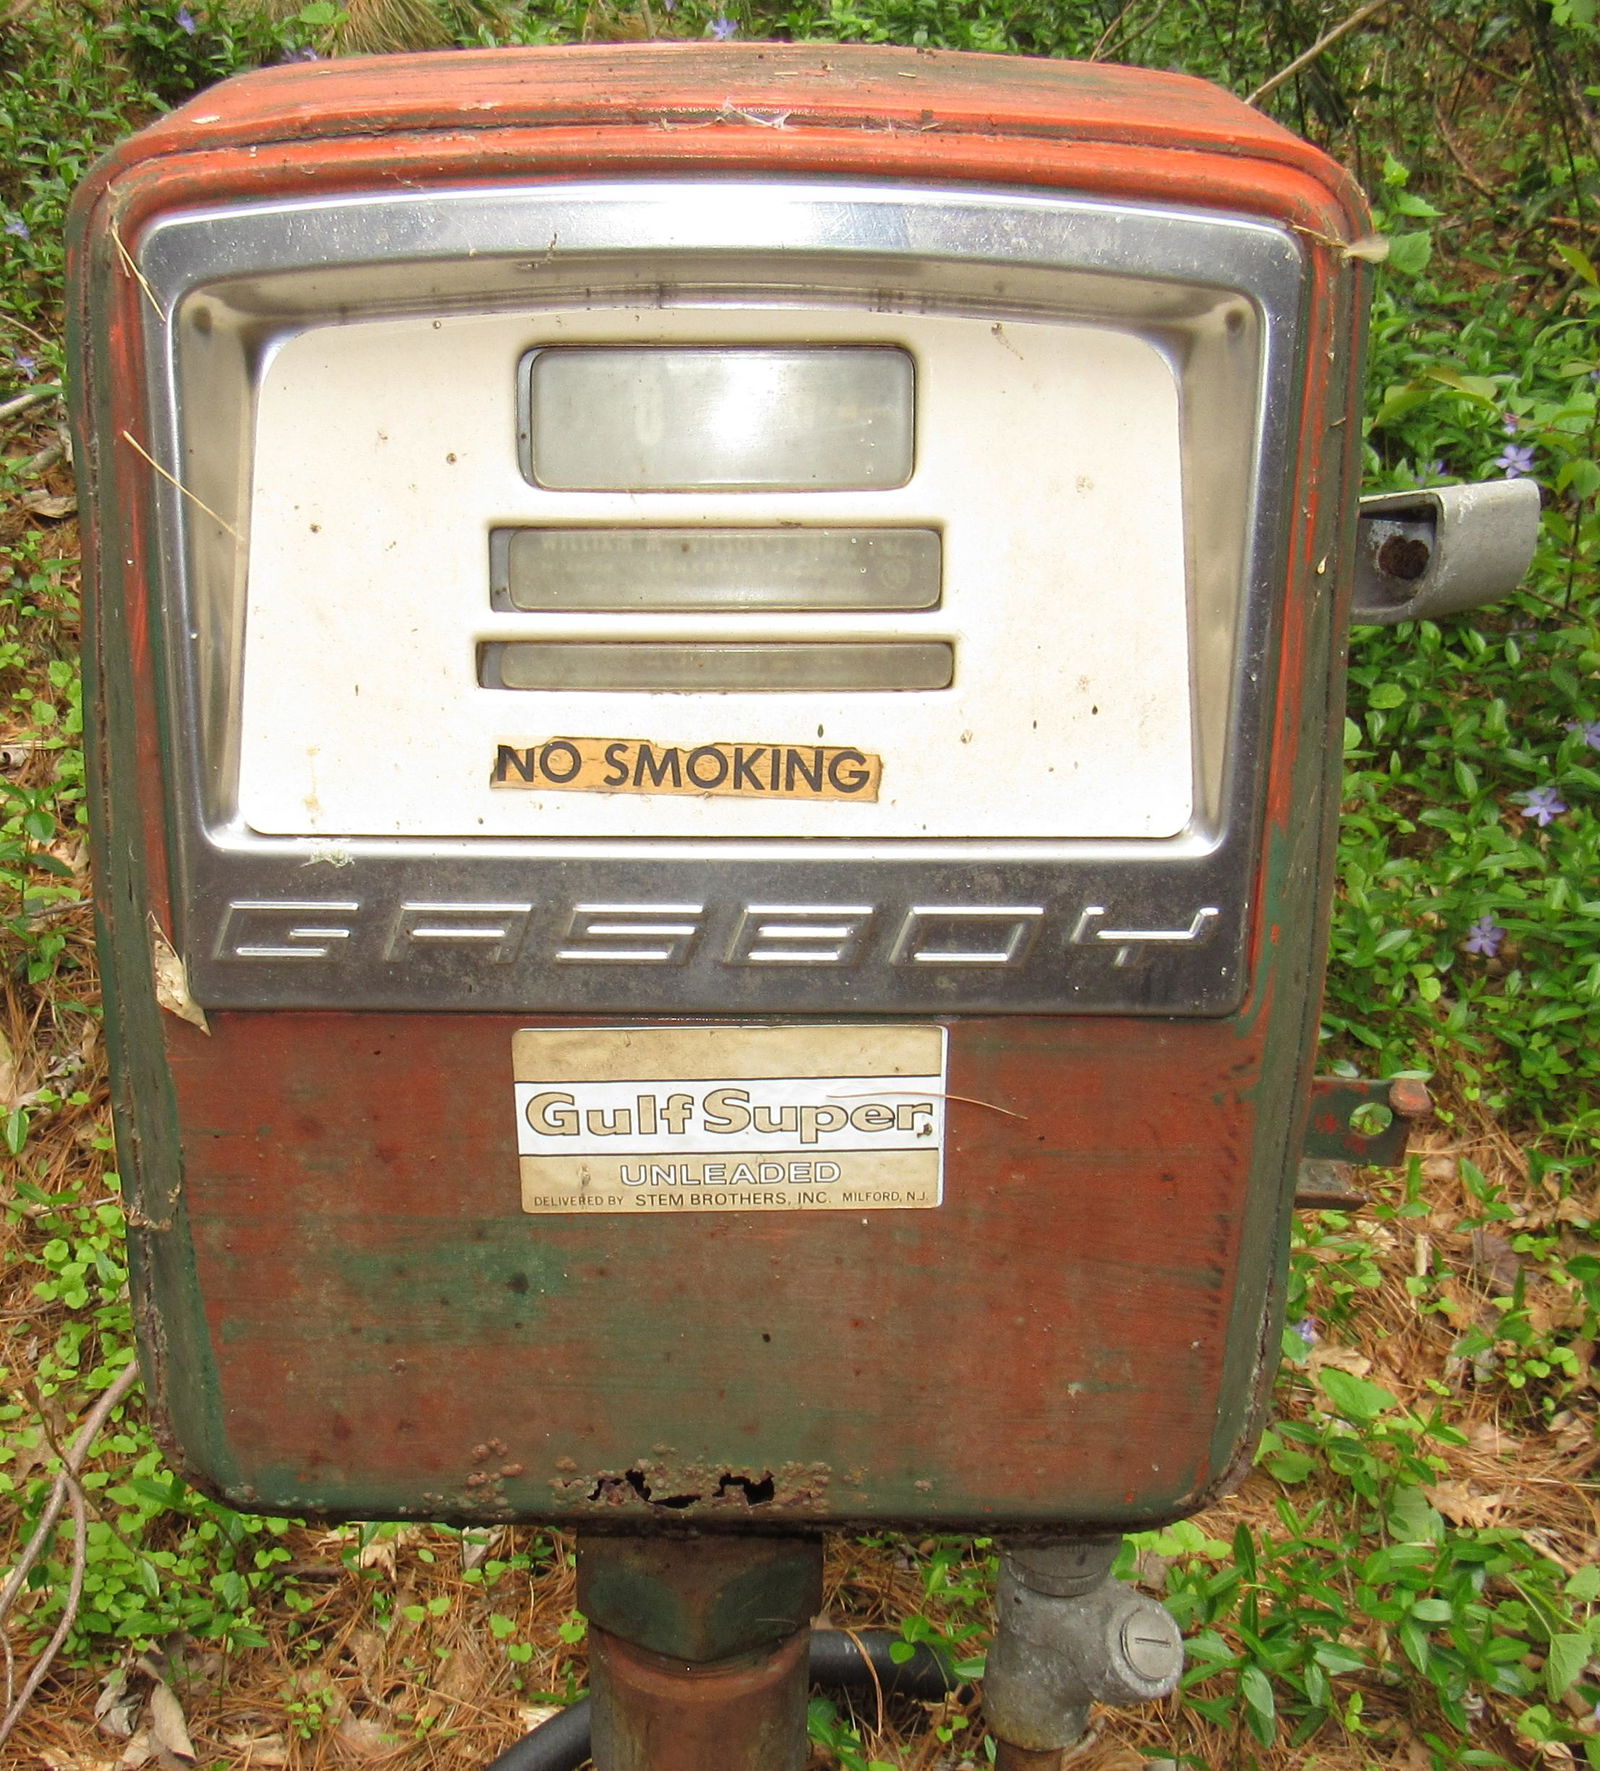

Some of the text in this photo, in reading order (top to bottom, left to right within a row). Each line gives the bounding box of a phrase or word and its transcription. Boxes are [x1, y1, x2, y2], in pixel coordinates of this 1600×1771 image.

[496, 740, 872, 793] NO SMOKING
[211, 899, 1224, 970] GASBOY
[526, 1088, 934, 1145] Gulf Super
[534, 1195, 604, 1207] DELIVERED
[608, 1195, 624, 1206] BY
[635, 1193, 684, 1207] STEM
[690, 1192, 792, 1207] BROTHERS,
[797, 1191, 832, 1205] INC.
[842, 1191, 902, 1203] MILFORD,
[620, 1161, 842, 1187] UNLEADED
